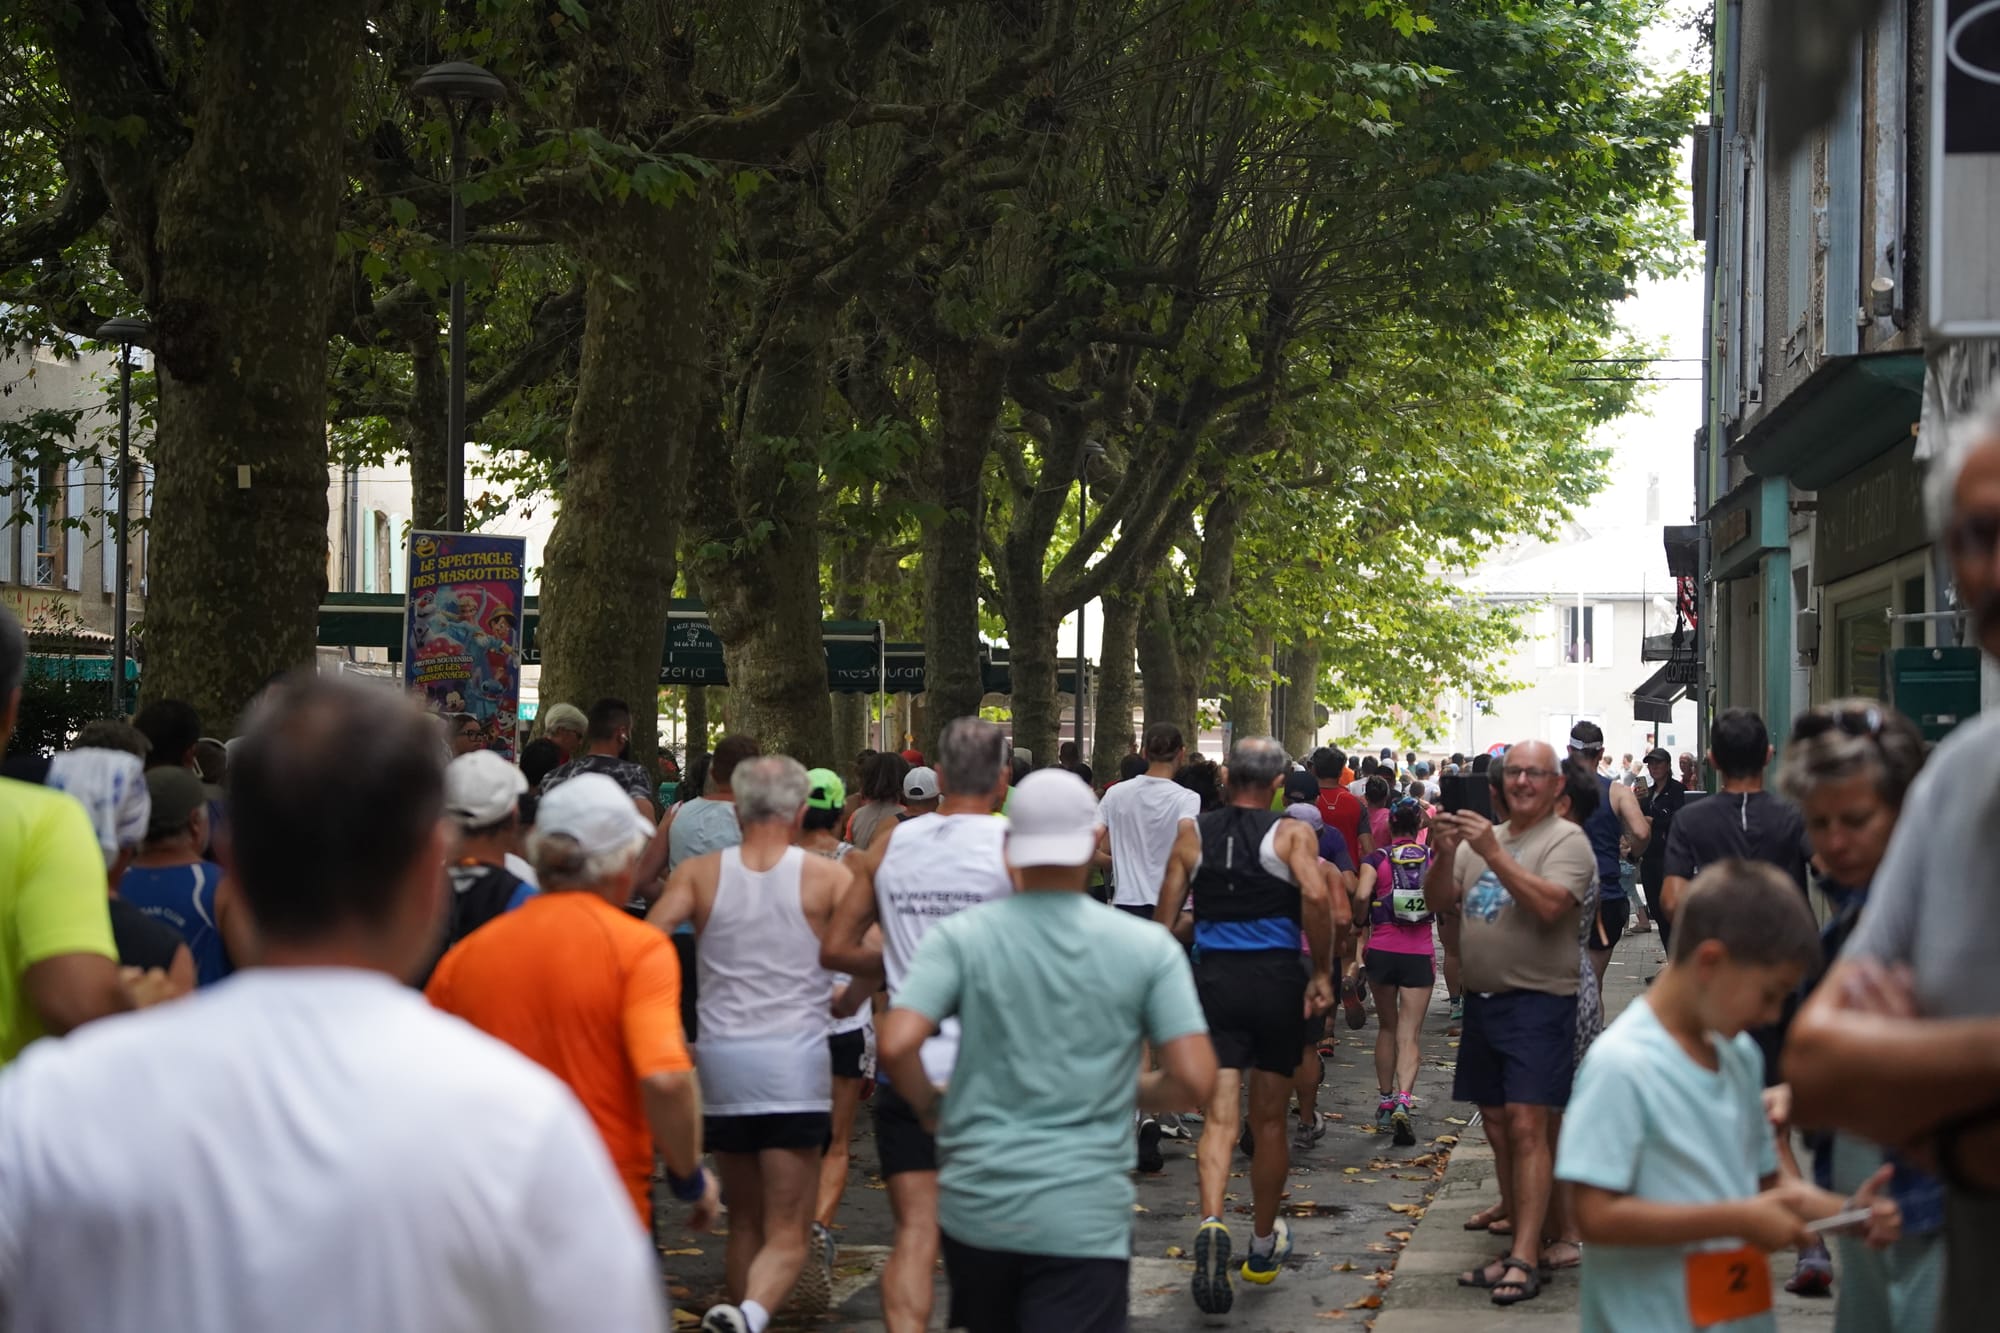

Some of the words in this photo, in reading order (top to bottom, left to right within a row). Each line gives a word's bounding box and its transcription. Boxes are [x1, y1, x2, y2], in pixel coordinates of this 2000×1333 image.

[420, 560, 435, 572] LE
[437, 552, 513, 569] SPECTACLE
[413, 574, 435, 589] DES
[438, 567, 519, 583] MASCOTTES
[414, 659, 436, 667] PHOTOS
[437, 655, 474, 664] SOUVENIRS
[427, 663, 444, 673] AVEC
[445, 663, 461, 671] LES
[416, 671, 471, 683] PERSONNAGES
[1727, 1262, 1750, 1294] 2
